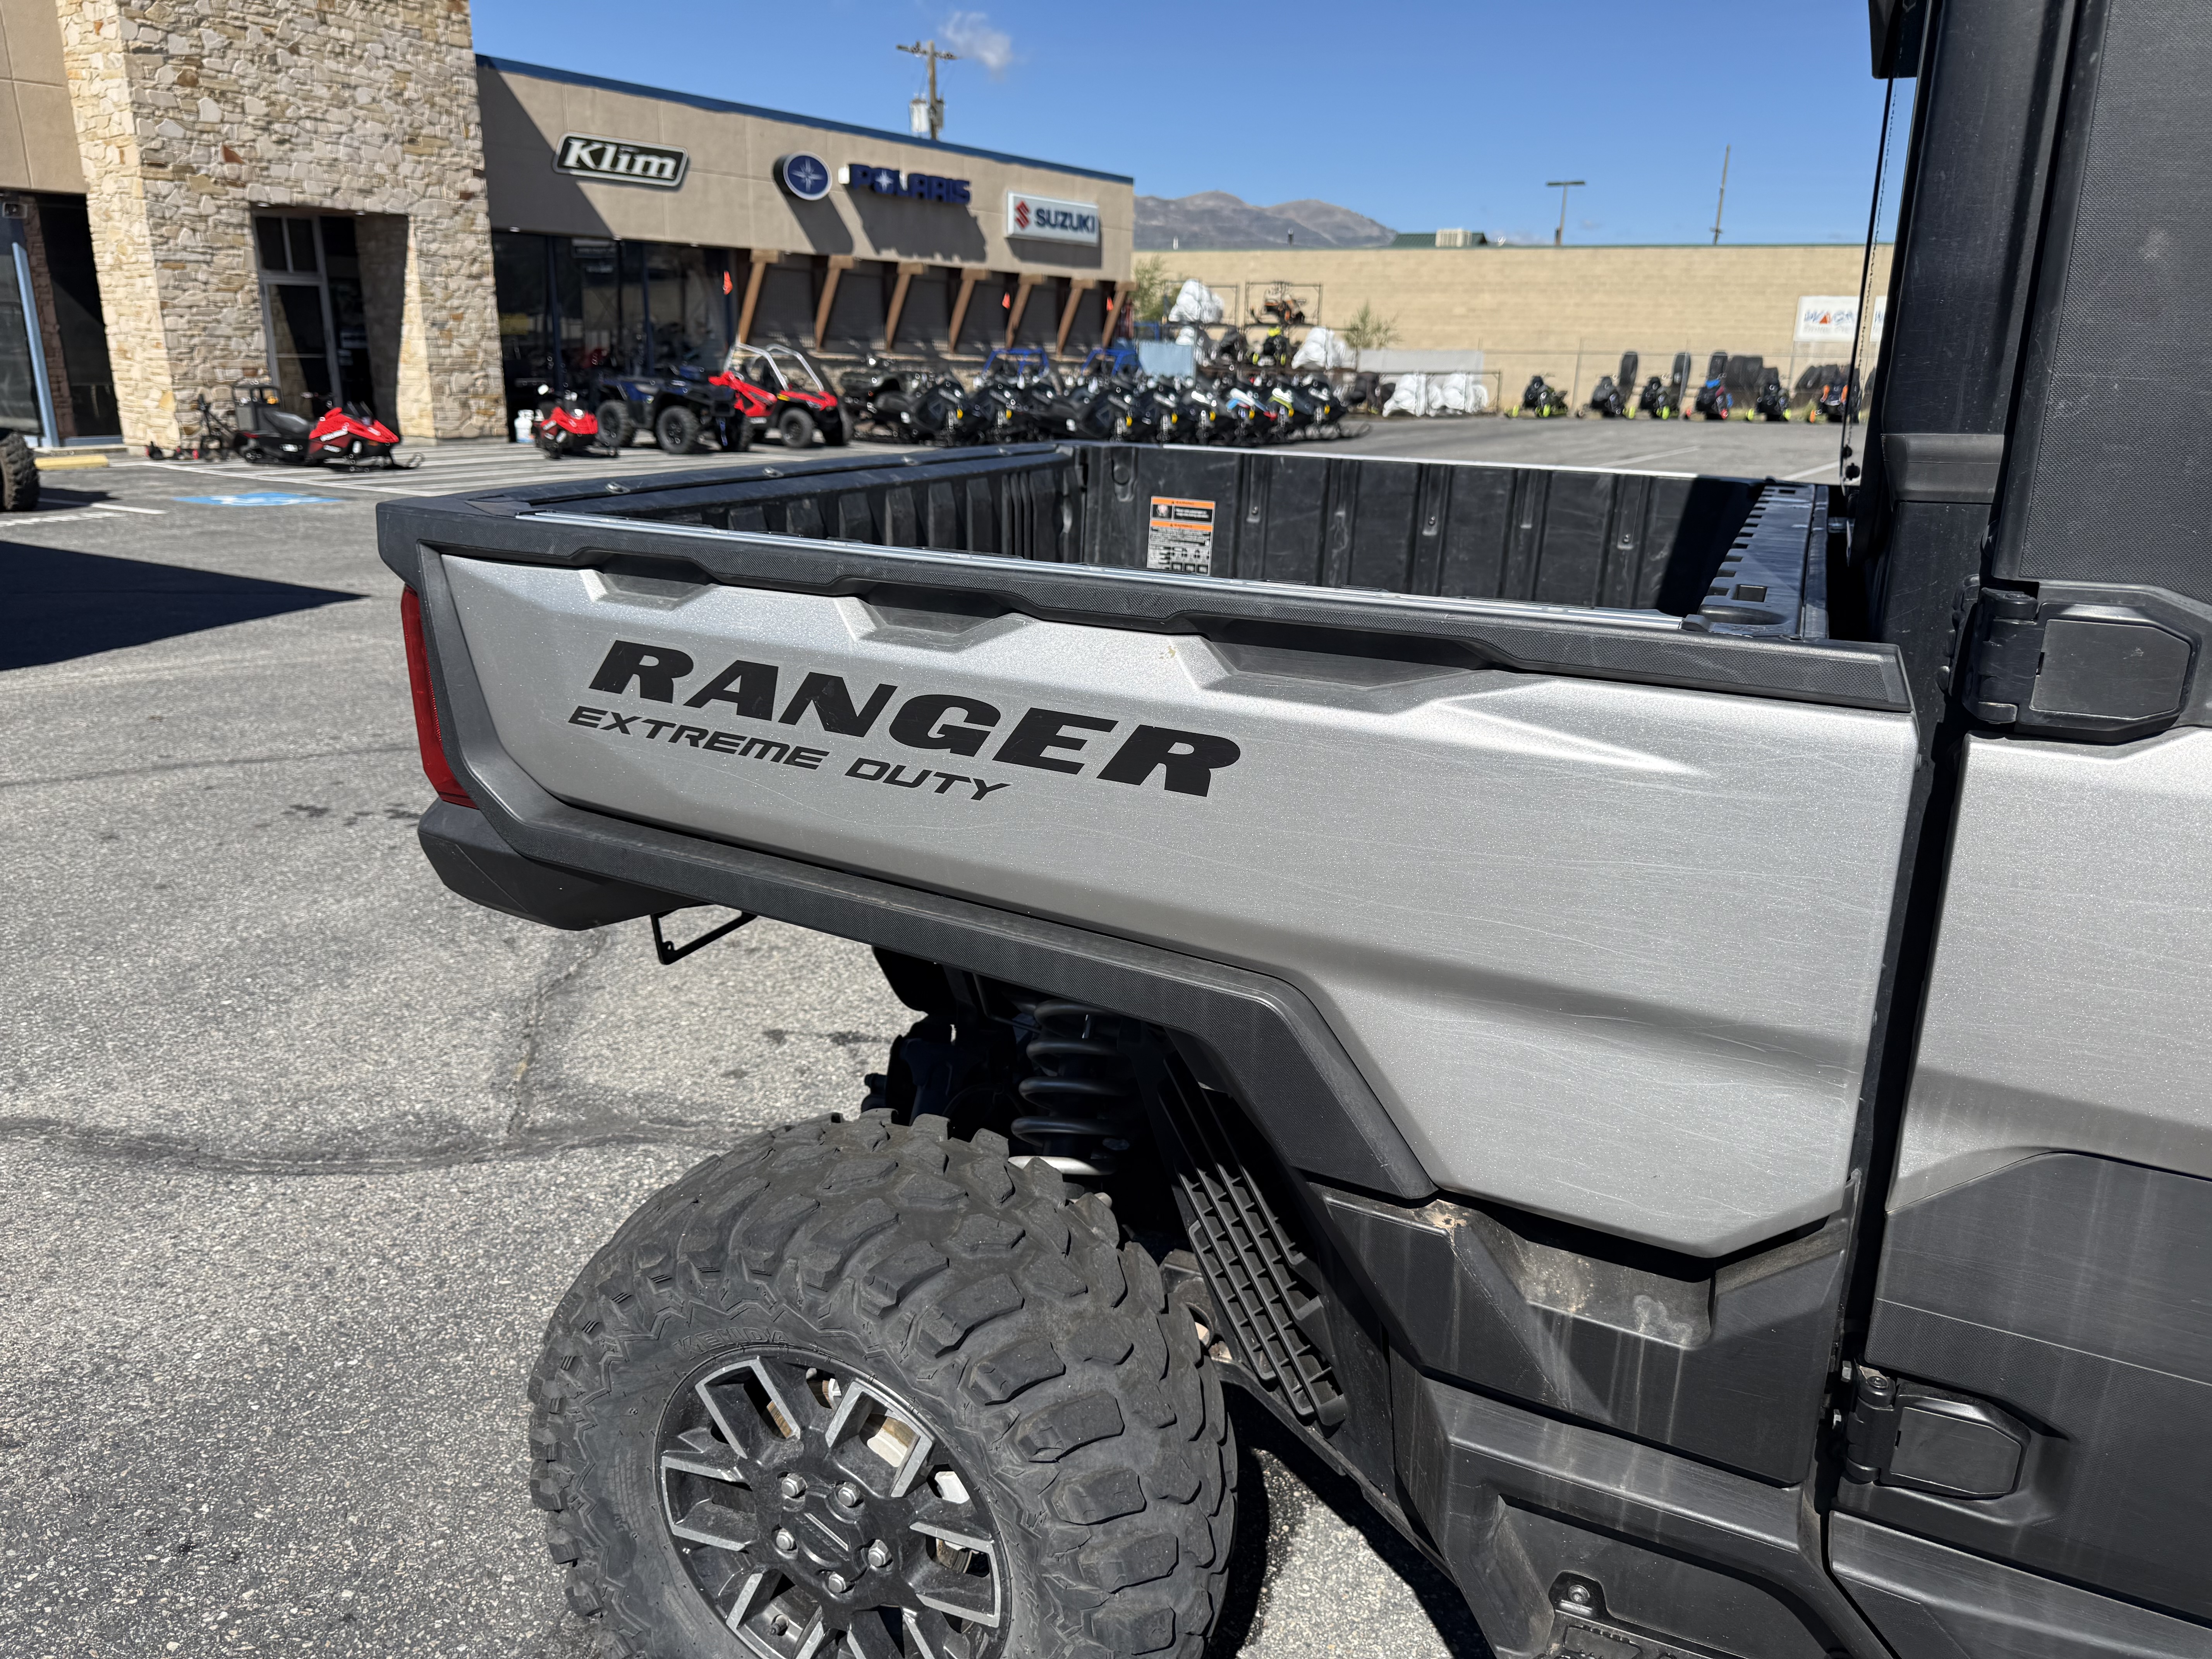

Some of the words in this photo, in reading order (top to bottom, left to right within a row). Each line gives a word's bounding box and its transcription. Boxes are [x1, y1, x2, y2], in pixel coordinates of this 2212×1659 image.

[563, 138, 677, 180] Klim
[847, 163, 970, 204] POLARIS
[1035, 208, 1095, 234] SUZUKI
[589, 640, 1240, 797] RANGER
[568, 706, 830, 769] EXTREME
[845, 758, 1011, 800] DUTY
[673, 1327, 795, 1360] KENDA
